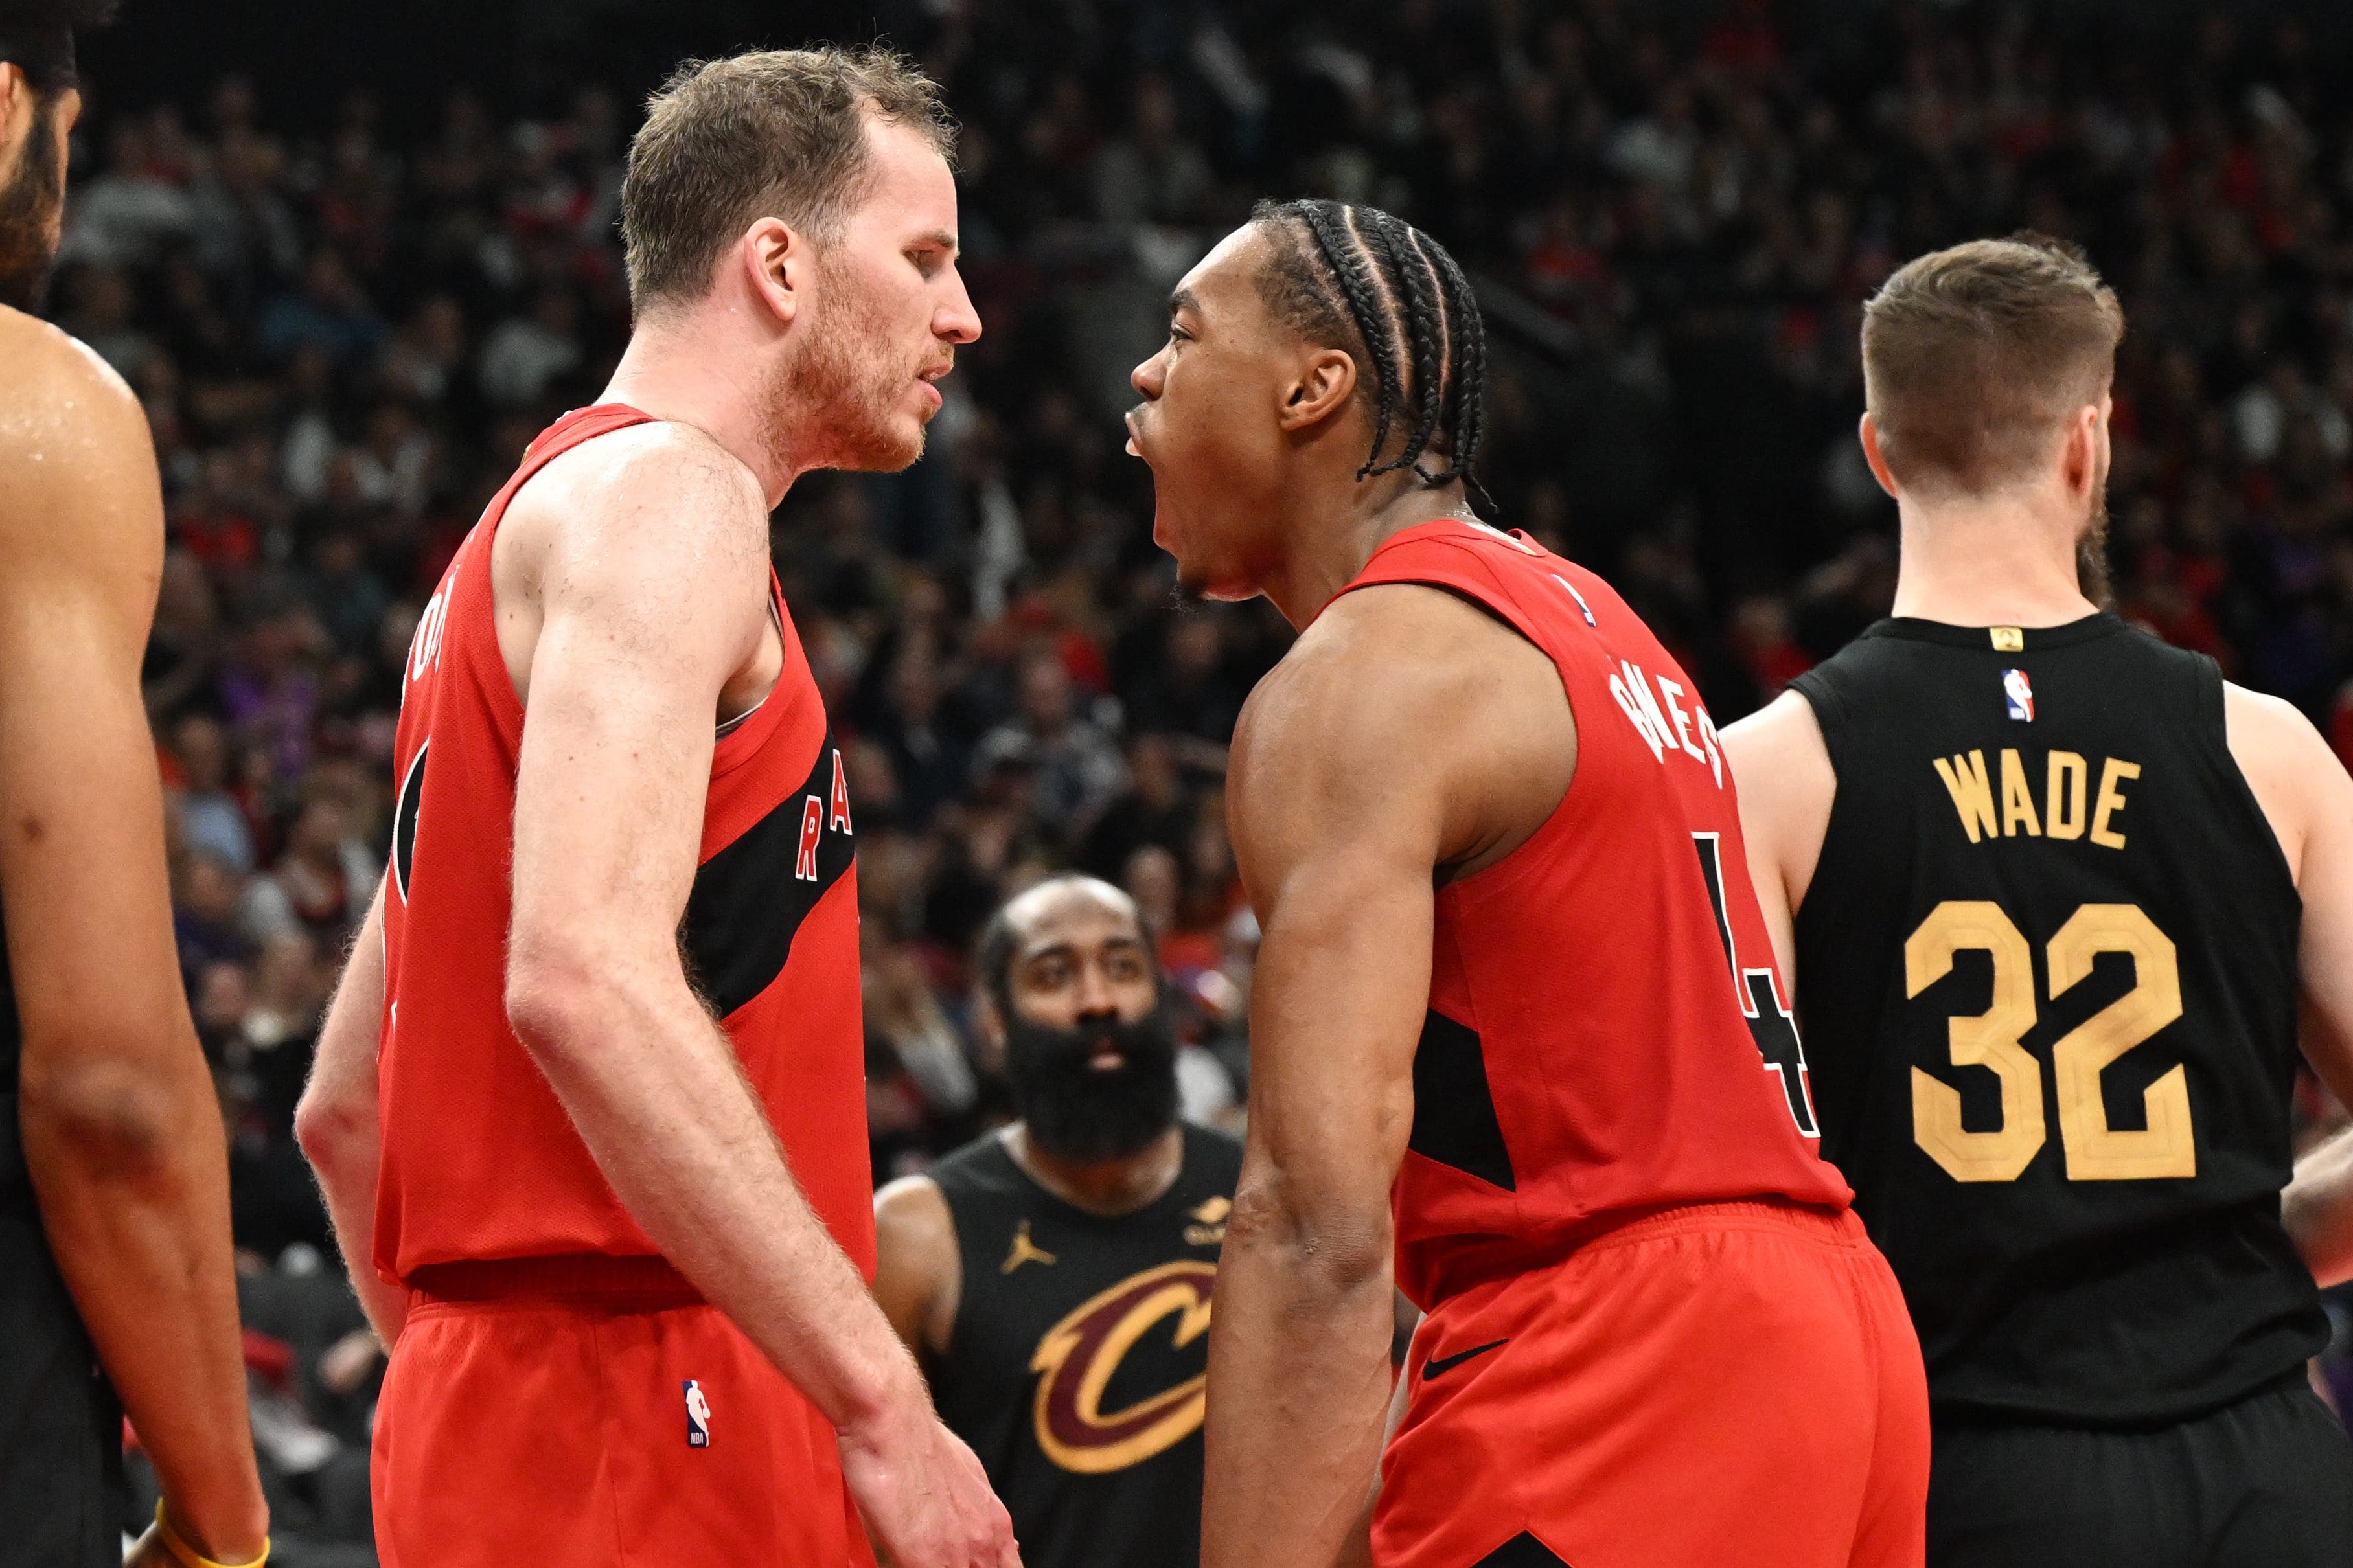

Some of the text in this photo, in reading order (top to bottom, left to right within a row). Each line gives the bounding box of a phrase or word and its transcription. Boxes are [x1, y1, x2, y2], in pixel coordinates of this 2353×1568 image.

[1933, 748, 2141, 850] WADE
[1905, 900, 2196, 1182] 32
[691, 1432, 704, 1444] NBA
